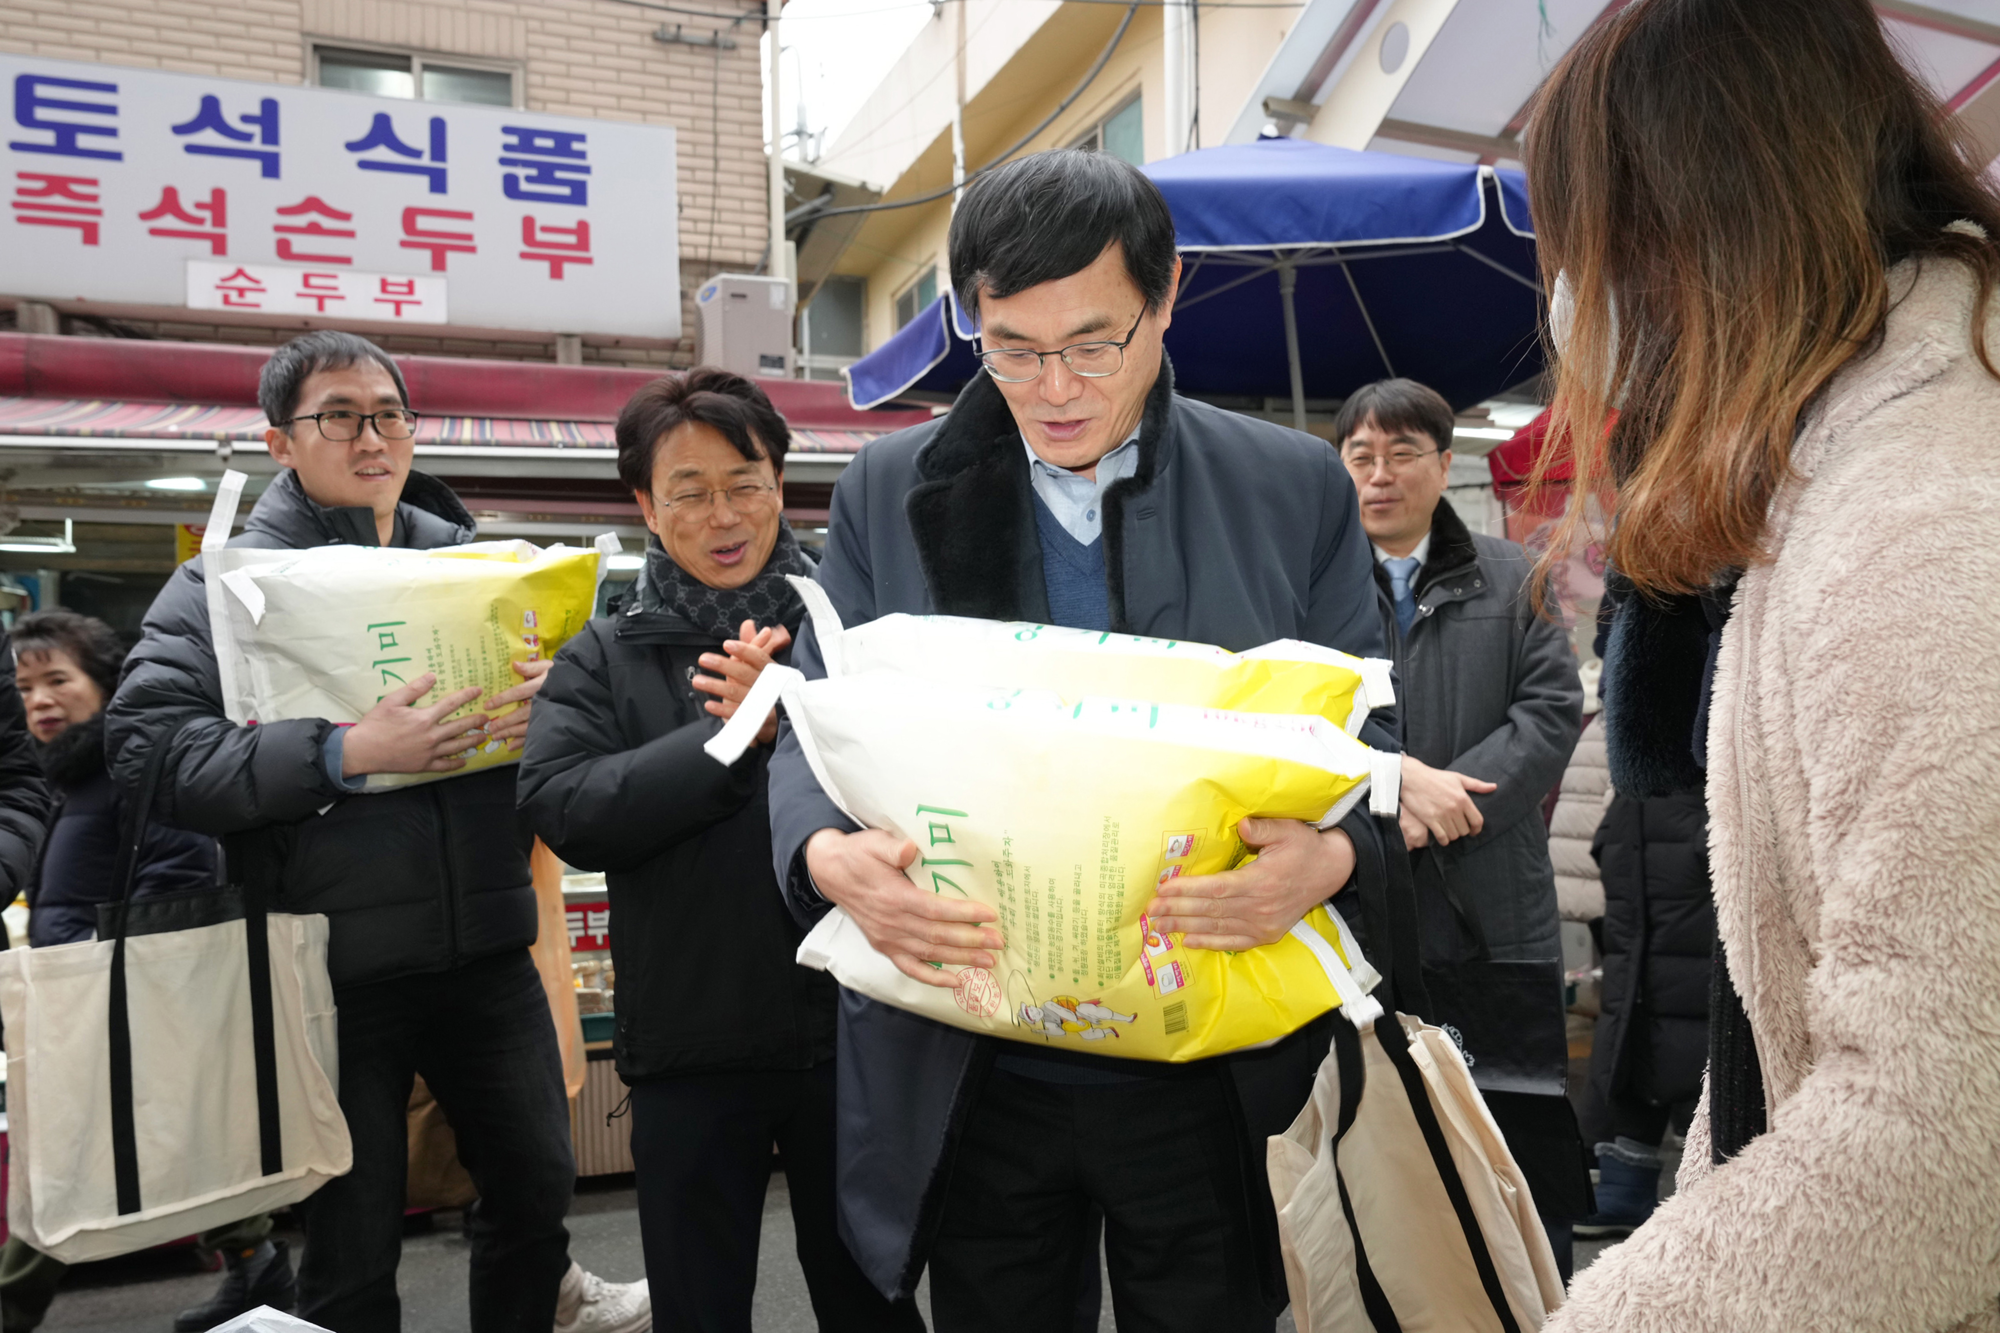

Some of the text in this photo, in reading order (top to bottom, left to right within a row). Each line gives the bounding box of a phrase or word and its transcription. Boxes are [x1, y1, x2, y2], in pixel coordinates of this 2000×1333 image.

[8, 73, 592, 207] 토석식품
[11, 171, 594, 281] 즉석손두부
[214, 267, 423, 318] 순두부
[367, 621, 418, 707] 기미
[1099, 815, 1112, 889] 미곡종합처리장에서
[1109, 821, 1120, 862] 품질관리로
[1023, 865, 1031, 895] 토지에서
[1048, 878, 1056, 908] 사용하여
[1107, 865, 1117, 889] 엄격한
[1097, 892, 1106, 916] 방식의
[1106, 894, 1116, 924] 가공하여
[566, 909, 610, 948] 두부
[1096, 919, 1105, 941] 컴퓨터
[968, 970, 987, 1012] 품질보증
